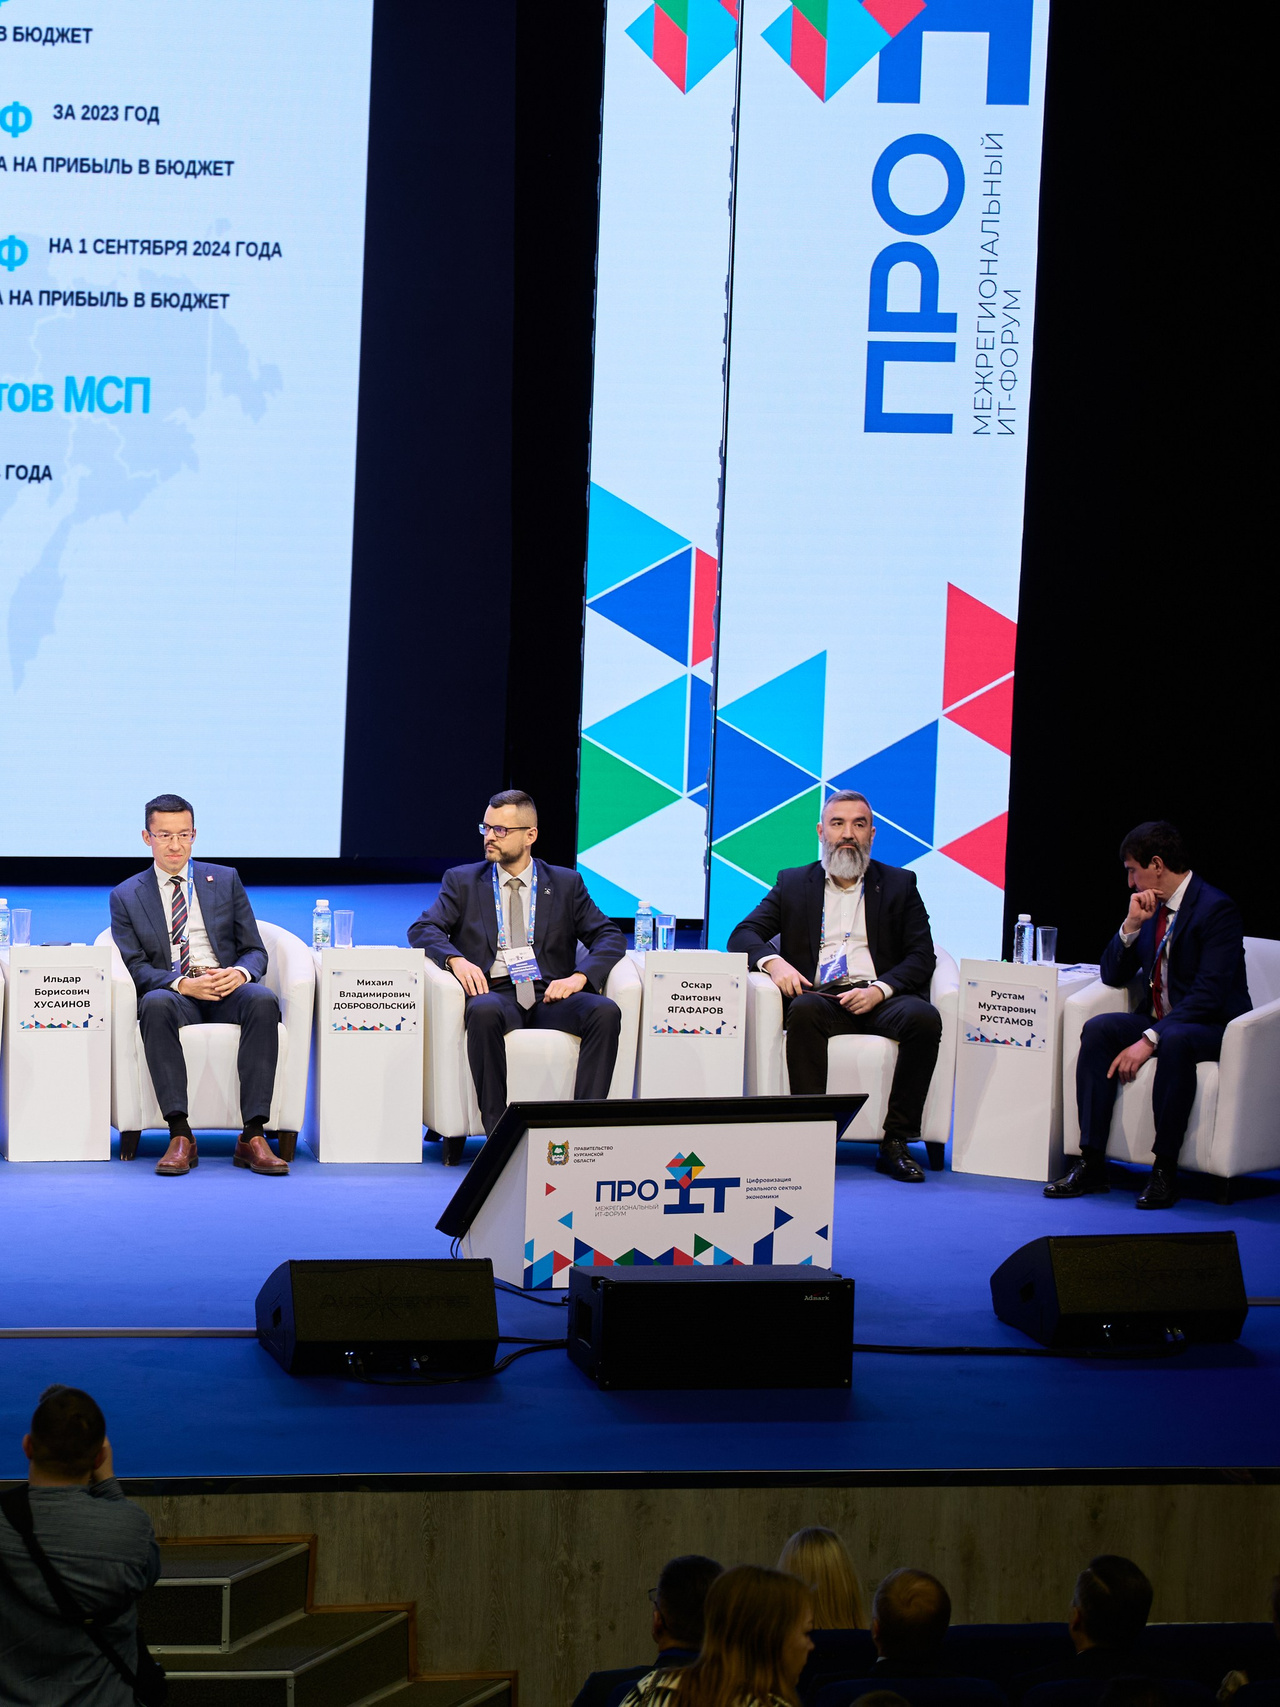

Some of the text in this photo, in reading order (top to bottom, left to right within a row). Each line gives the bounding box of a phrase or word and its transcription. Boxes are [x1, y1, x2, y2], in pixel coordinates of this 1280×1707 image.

[13, 26, 93, 46] БЮДЖЕТ
[54, 104, 159, 125] ЗА 2023 ГОД
[14, 157, 37, 172] НА
[43, 157, 132, 174] ПРИБЫЛЬ
[139, 159, 149, 174] В
[156, 160, 234, 178] БЮДЖЕТ
[49, 238, 282, 260] НА 1 СЕНТЯБРЯ 2024 ГОДА
[864, 133, 966, 434] ПРО
[972, 132, 1003, 435] МЕЖРЕГИОНАЛЬНЫЙ
[10, 290, 33, 305] НА
[39, 290, 128, 307] ПРИБЫЛЬ
[134, 292, 145, 307] В
[151, 292, 230, 311] БЮДЖЕТ
[997, 289, 1021, 435] ИТ-ФОРУМ
[64, 376, 150, 414] МСП
[6, 465, 52, 483] ГОДА
[43, 975, 82, 984] Ильдар
[680, 980, 713, 991] Оскар
[34, 988, 90, 998] Борисович
[339, 990, 411, 1000] Владимирович
[670, 993, 721, 1002] Фаитович
[990, 990, 1025, 1001] Рустам
[33, 1000, 91, 1009] ХУСАИНОВ
[333, 1002, 416, 1011] ДОБРОВОЛЬСКИЙ
[667, 1005, 724, 1015] ЯГАФАРОВ
[978, 1001, 1037, 1015] Мухтарович
[980, 1014, 1034, 1027] РУСТАМОВ
[596, 1179, 659, 1202] ПРО
[595, 1204, 659, 1212] МЕЖРЕГИОНАЛЬНЫЙ
[594, 1211, 627, 1219] ИТ-ФОРУМ
